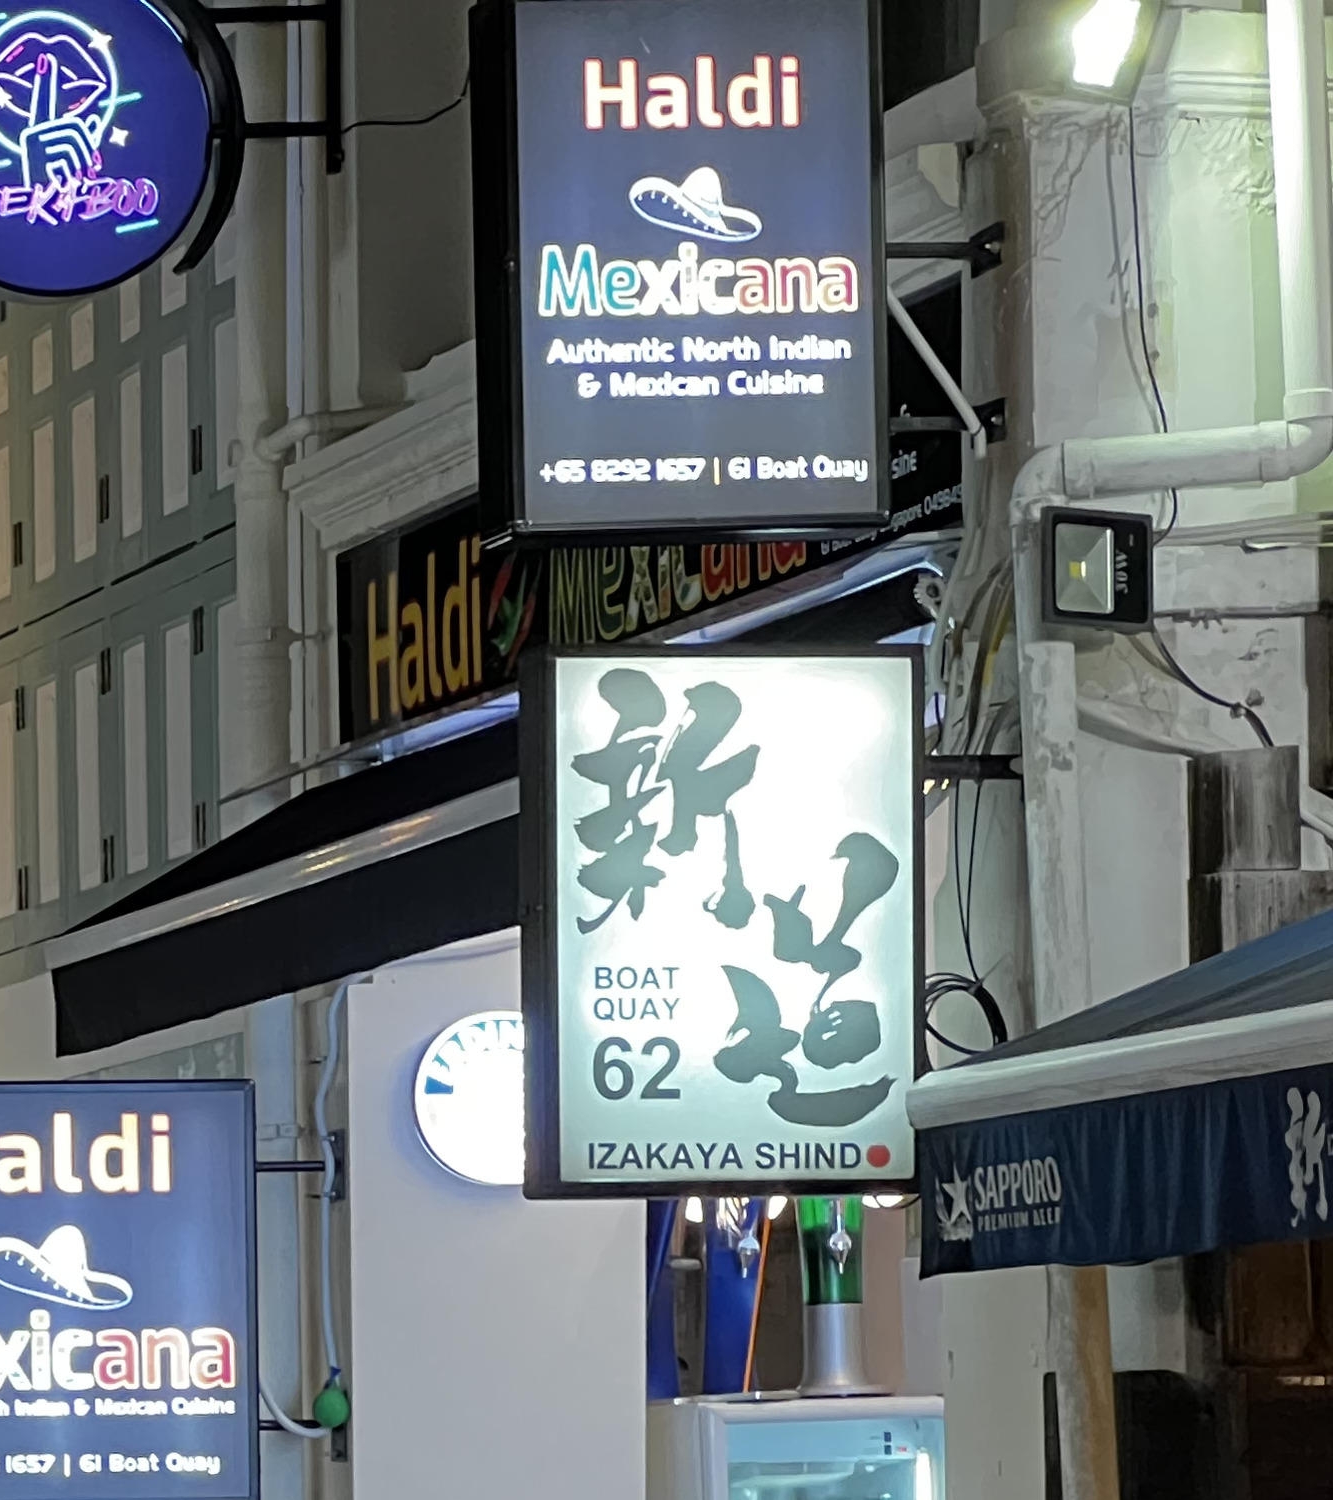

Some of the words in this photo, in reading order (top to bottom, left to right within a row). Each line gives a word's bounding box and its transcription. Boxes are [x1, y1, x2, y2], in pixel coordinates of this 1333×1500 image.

[582, 54, 801, 130] Haldi
[538, 242, 860, 318] Mexicana
[546, 336, 675, 364] Authentic
[682, 336, 761, 362] North
[769, 334, 852, 361] Indian
[577, 373, 601, 399] &
[609, 371, 720, 397] Mexican
[727, 370, 825, 396] Cuisine
[539, 457, 586, 482] +65
[590, 457, 651, 482] 8292
[756, 455, 808, 480] Boat
[812, 454, 869, 482] Quay
[366, 534, 482, 722] Haldi
[593, 966, 681, 991] BOAT
[593, 997, 681, 1022] QUAY
[592, 1037, 683, 1101] 62
[587, 1143, 744, 1170] IZAKAYA
[973, 1155, 1063, 1212] SAPPORO
[73, 1398, 91, 1417] &
[94, 1397, 168, 1417] Mexican
[171, 1396, 237, 1416] Cuisine
[5, 1453, 56, 1476] 1657
[108, 1452, 160, 1475] Boat
[165, 1451, 221, 1476] Quay
